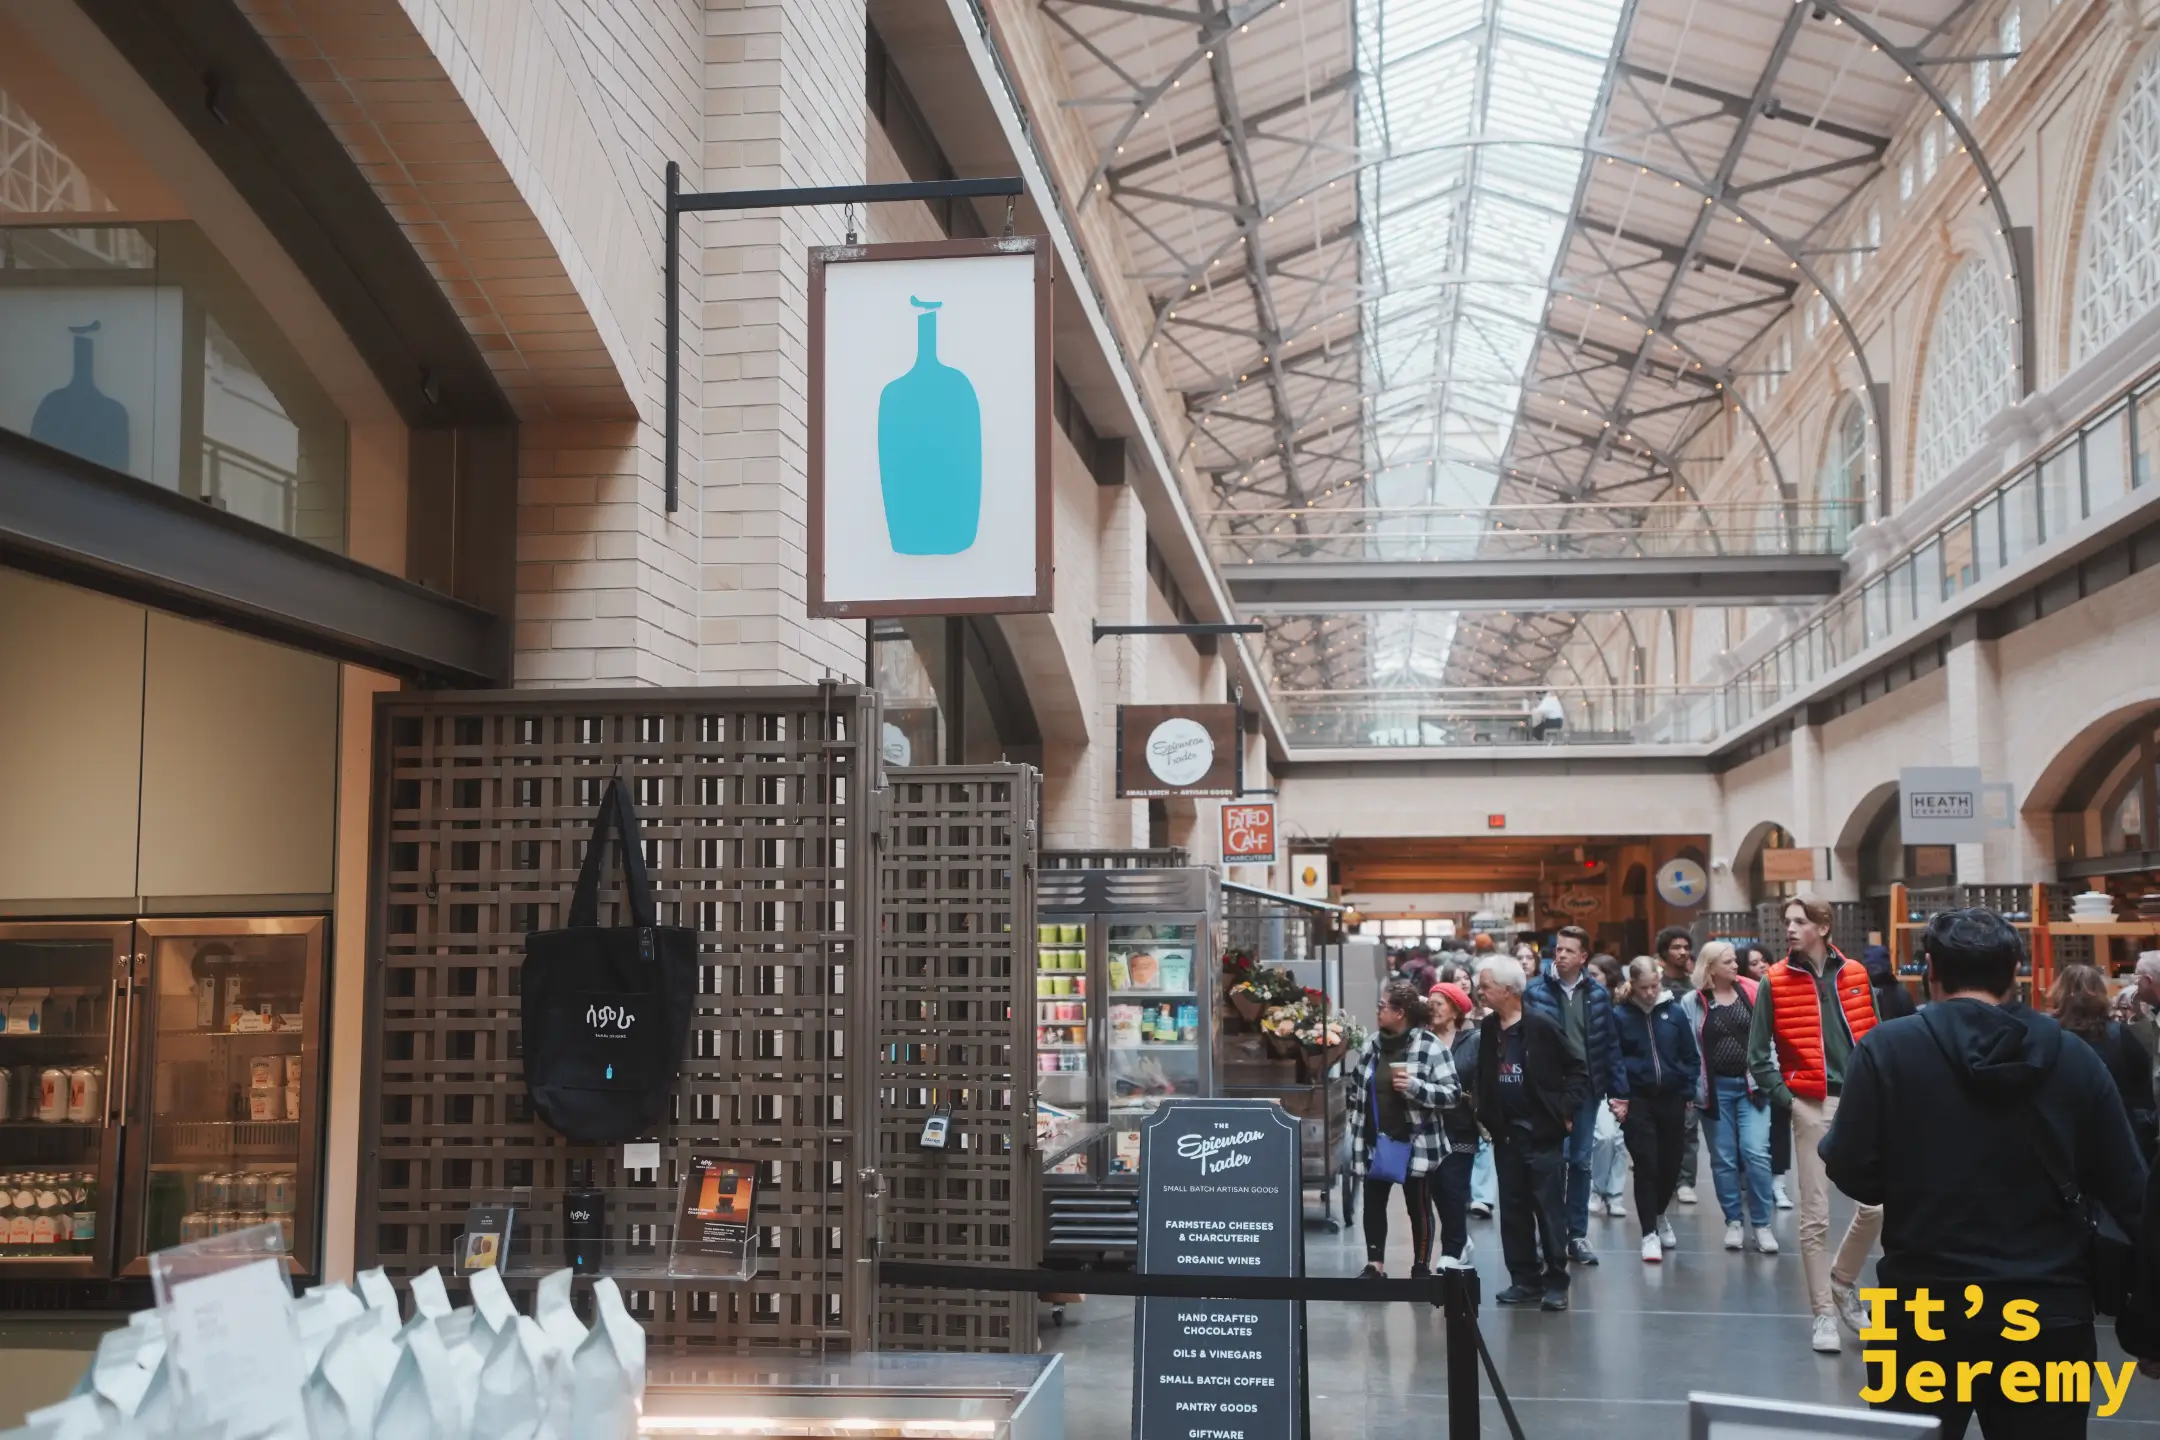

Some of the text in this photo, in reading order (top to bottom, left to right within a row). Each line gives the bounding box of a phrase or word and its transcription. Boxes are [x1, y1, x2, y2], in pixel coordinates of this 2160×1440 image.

[1152, 738, 1204, 756] Epicurean
[1161, 750, 1198, 766] Trader
[1915, 796, 1968, 807] HEATH
[1227, 808, 1270, 829] FATTED
[1228, 828, 1267, 852] CALF
[1177, 1130, 1264, 1157] Epicurean
[1190, 1149, 1251, 1176] Trader
[1163, 1185, 1188, 1193] SMALL
[1190, 1185, 1215, 1193] BATCH
[1251, 1186, 1279, 1194] GOODS
[1165, 1220, 1274, 1231] FARMSTEAD CHEESES
[1179, 1233, 1260, 1243] & CHARCUTERIE
[1177, 1255, 1261, 1265] ORGANIC WINES
[1178, 1313, 1259, 1324] HAND CRAFTED
[1183, 1326, 1253, 1336] CHOCOLATES
[1173, 1348, 1263, 1360] OILS & VINEGARS
[1159, 1375, 1275, 1387] SMALL BATCH COFFEE
[1176, 1402, 1258, 1413] PANTRY GOODS
[1188, 1429, 1244, 1439] GIFTWARE
